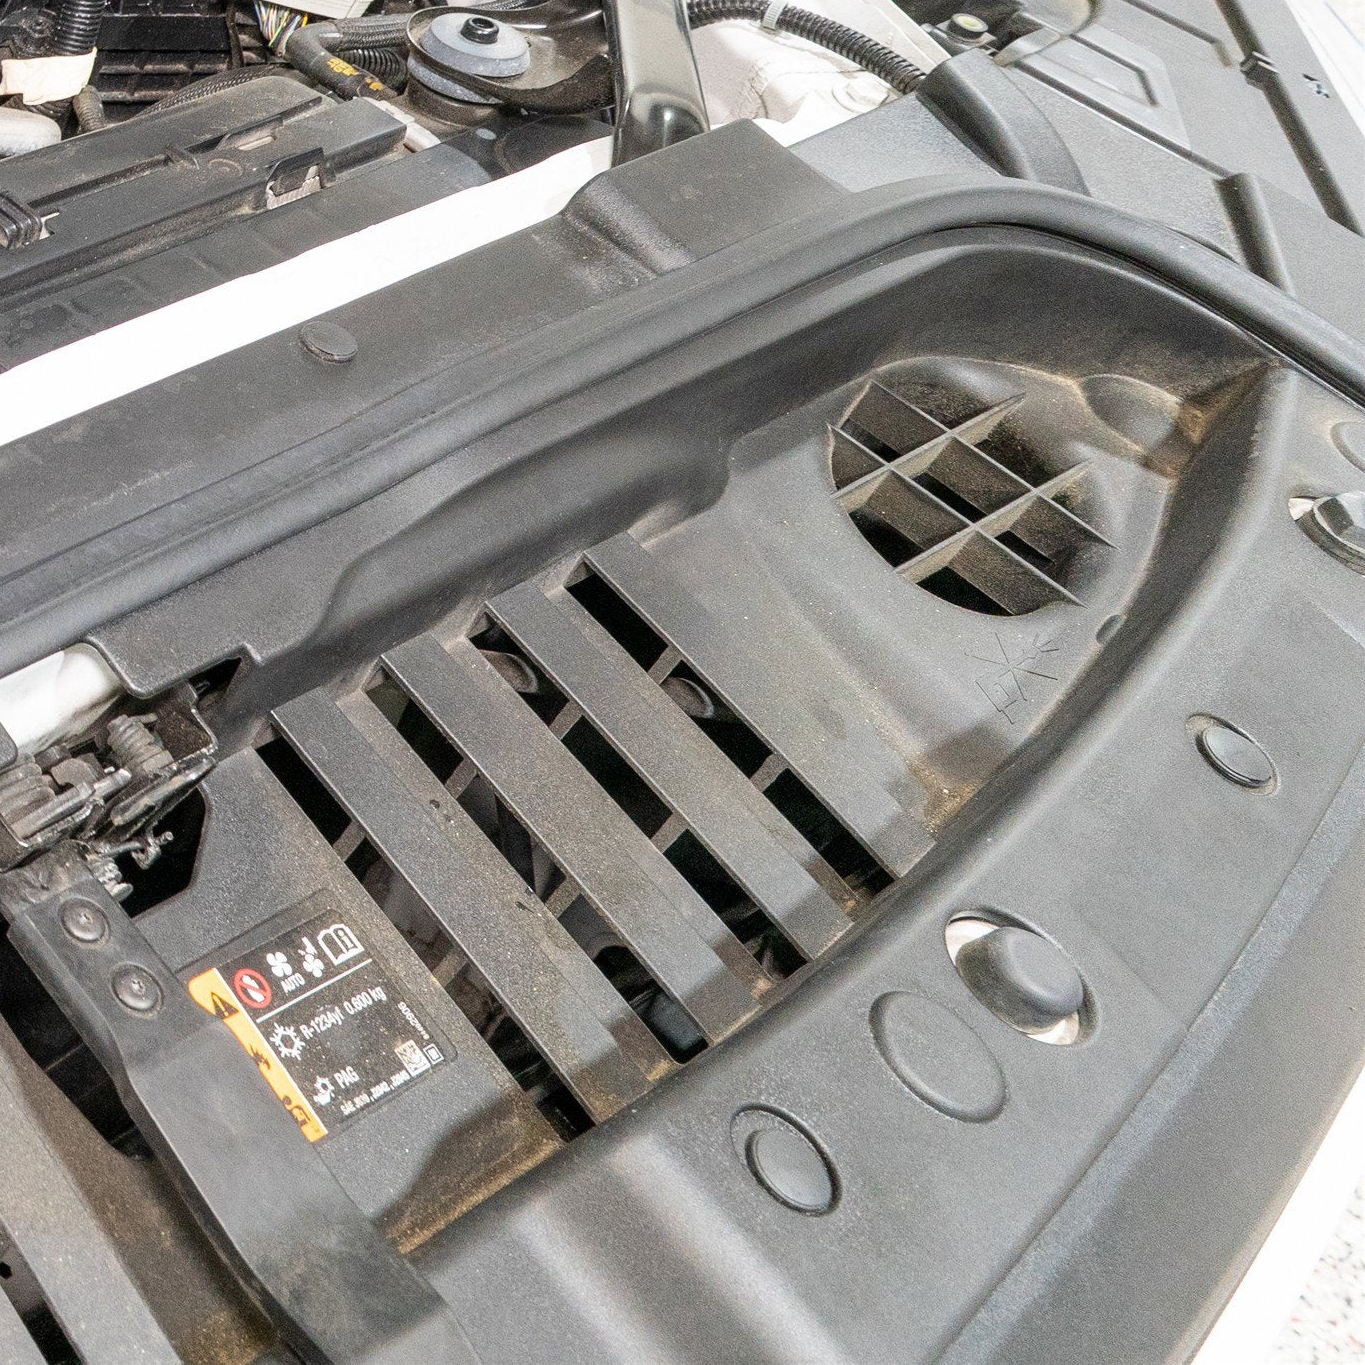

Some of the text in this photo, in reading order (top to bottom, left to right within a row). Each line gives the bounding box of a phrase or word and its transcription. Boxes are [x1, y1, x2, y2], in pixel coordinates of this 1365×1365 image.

[280, 973, 306, 993] AUTO
[300, 986, 387, 1040] R-1234yf 0.600 kg
[333, 1065, 360, 1089] PAG
